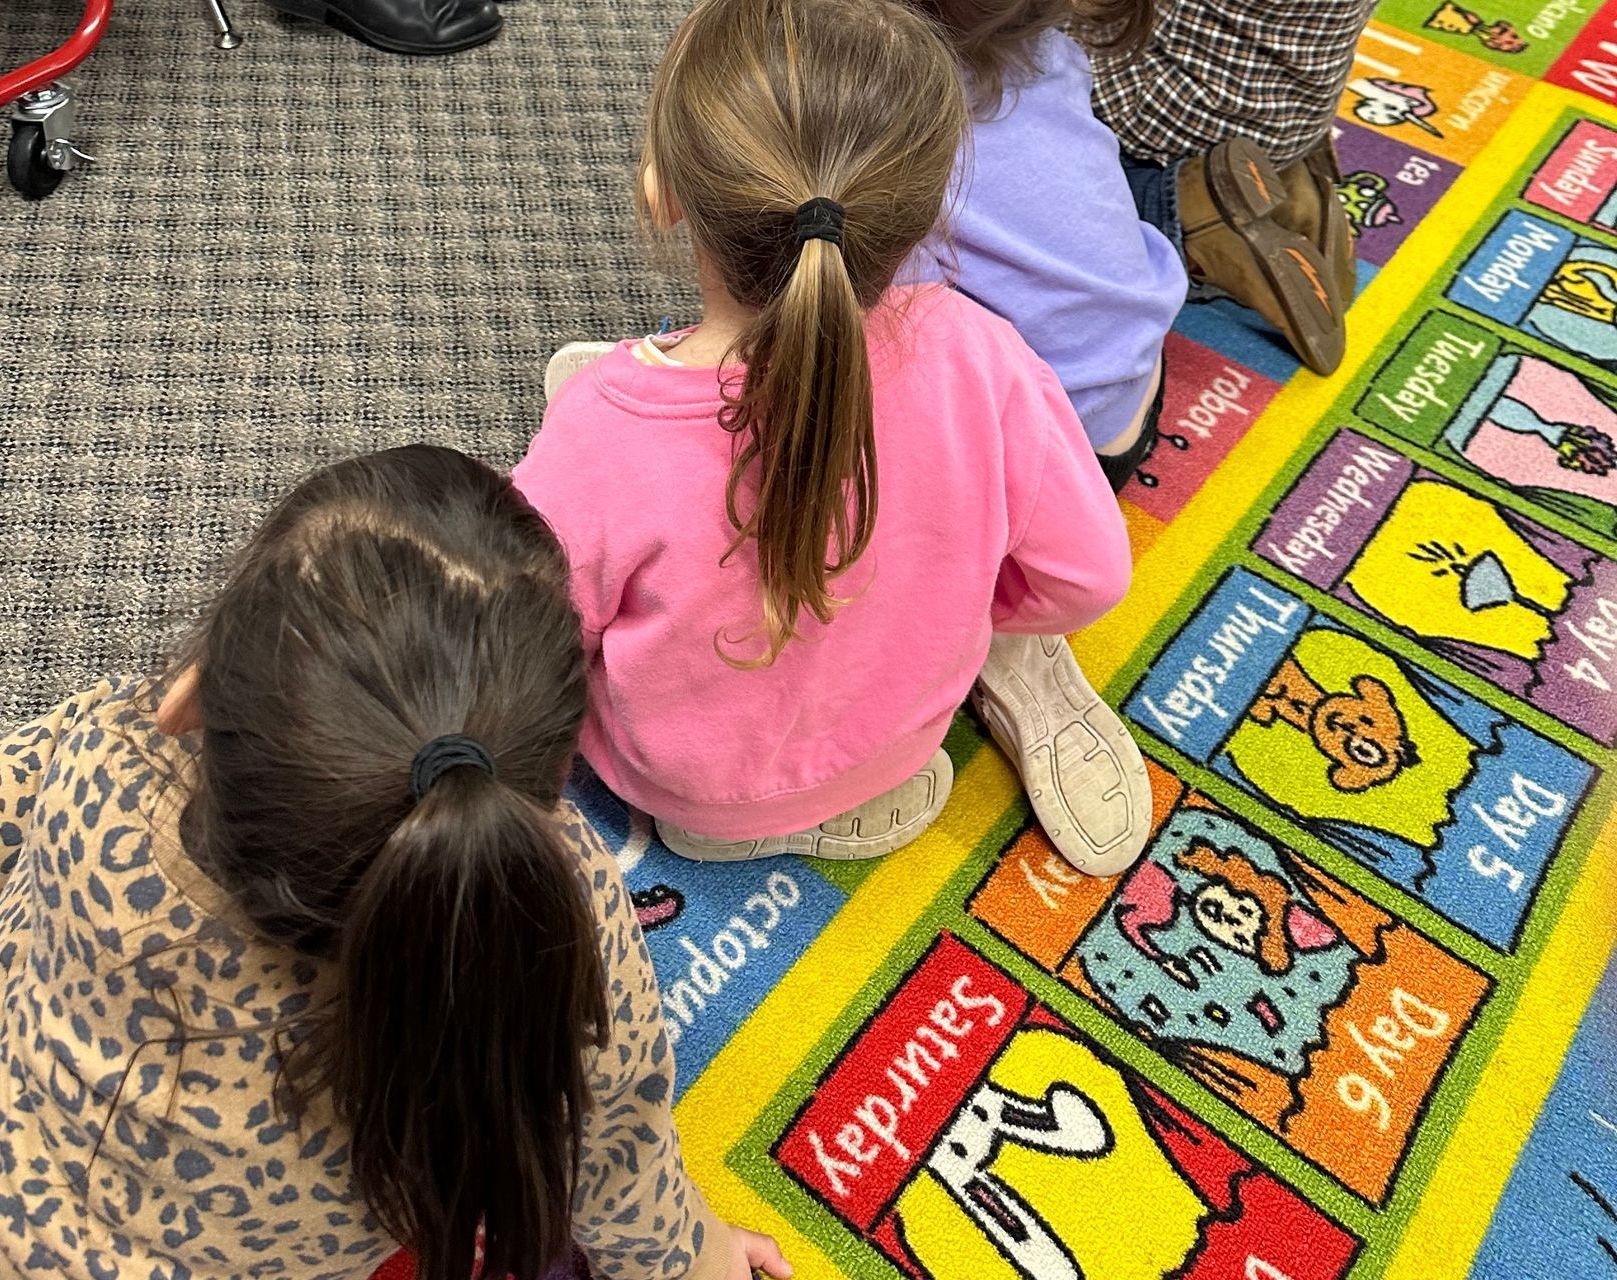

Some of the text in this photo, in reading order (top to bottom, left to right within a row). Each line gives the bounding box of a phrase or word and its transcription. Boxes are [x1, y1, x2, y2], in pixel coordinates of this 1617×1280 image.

[1447, 70, 1512, 132] unicorn
[1395, 155, 1442, 186] tea
[1538, 138, 1617, 206] Sunday
[1463, 220, 1561, 304] Monday
[1177, 365, 1252, 439] robot
[1377, 331, 1486, 424] Tuesday
[1267, 444, 1401, 575] Wednesday
[1142, 586, 1299, 741] Thursday
[1563, 658, 1613, 693] 4
[1467, 771, 1568, 894] Day 5
[807, 974, 1007, 1197] Saturday
[1335, 986, 1451, 1132] Day 6
